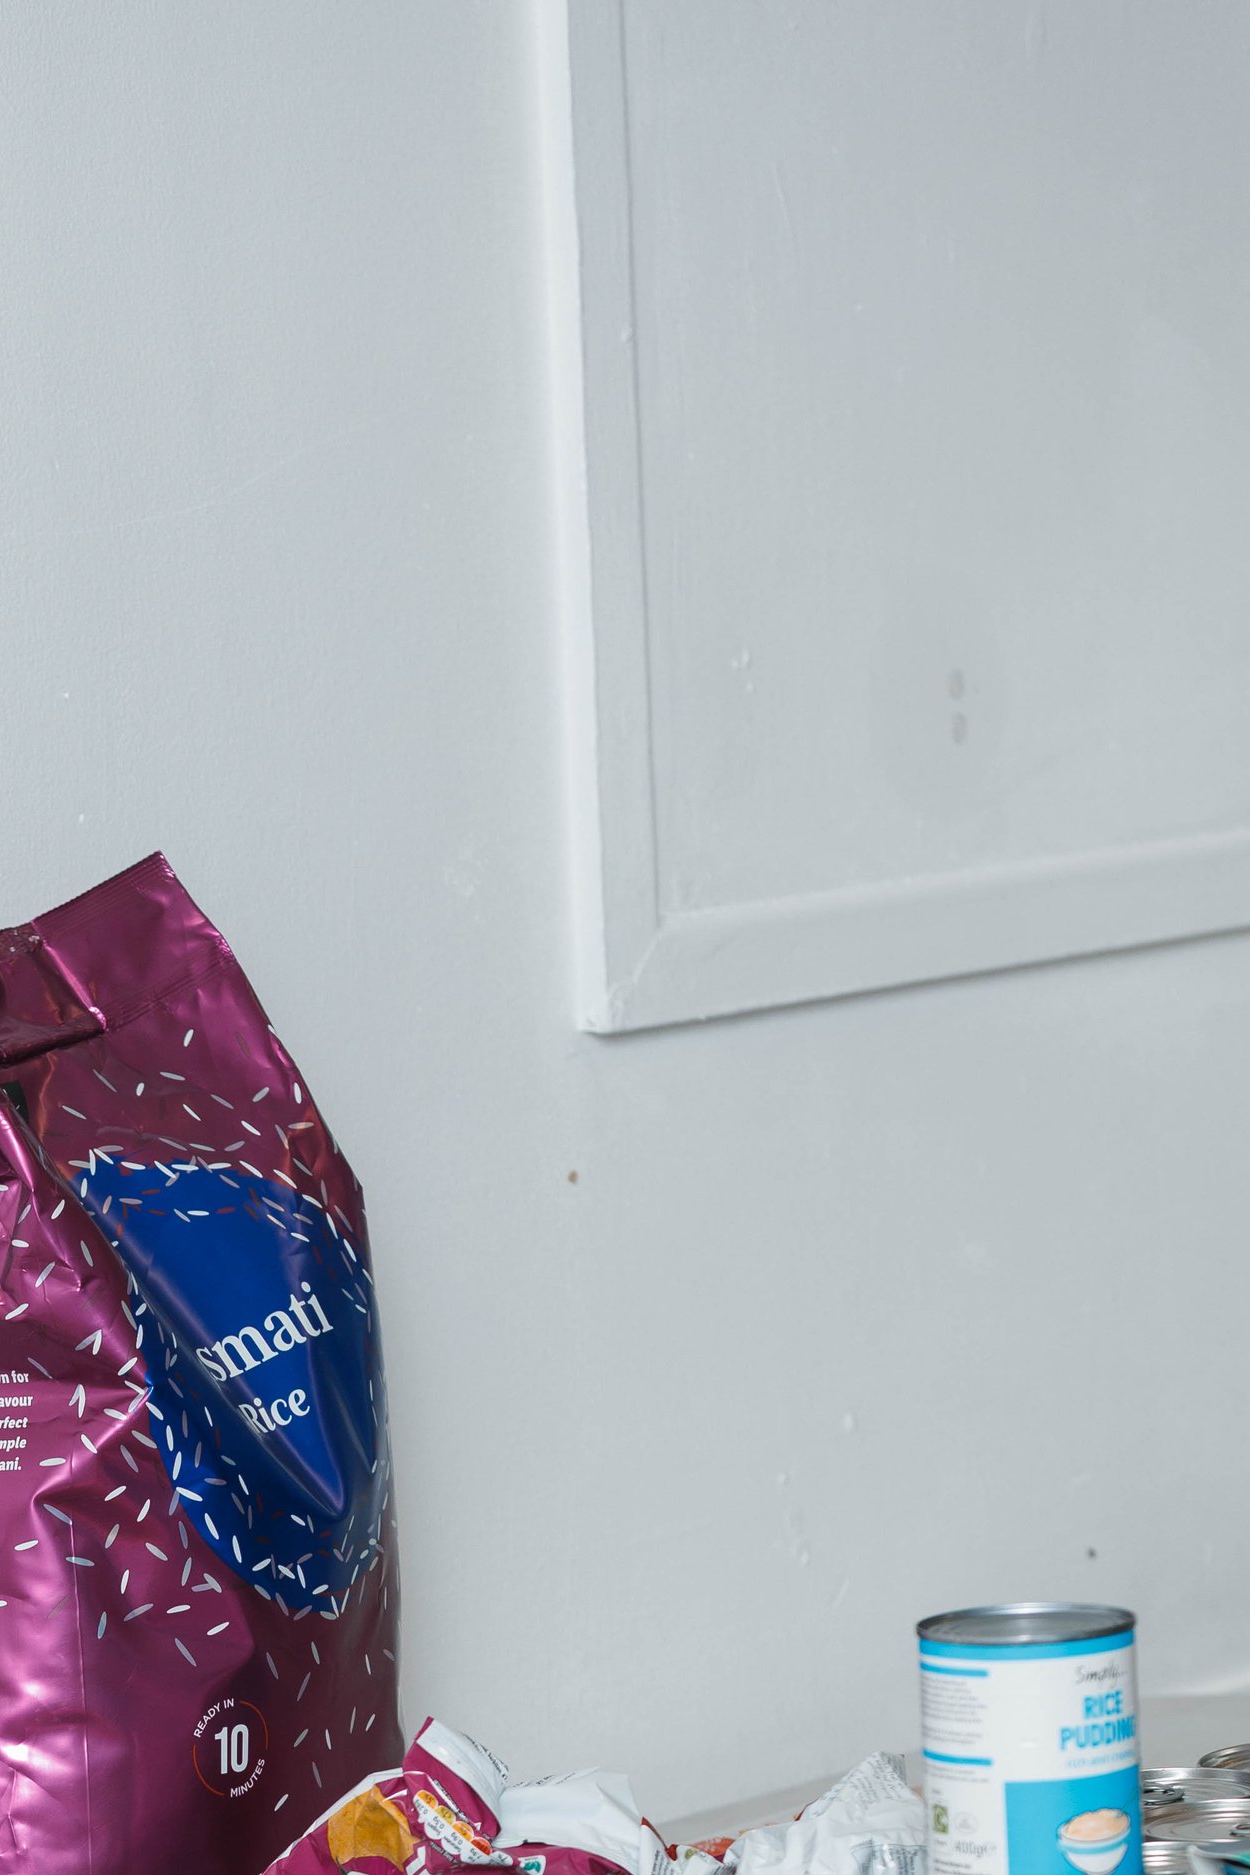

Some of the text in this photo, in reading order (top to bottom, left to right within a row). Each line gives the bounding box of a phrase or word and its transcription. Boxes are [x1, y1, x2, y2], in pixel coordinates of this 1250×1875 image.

[195, 1280, 335, 1384] smati
[11, 1370, 30, 1384] for
[237, 1385, 312, 1435] Rice
[193, 1698, 235, 1739] READY IN
[1083, 1690, 1123, 1720] RICE
[214, 1723, 249, 1775] 10
[229, 1757, 266, 1799] MINUTES
